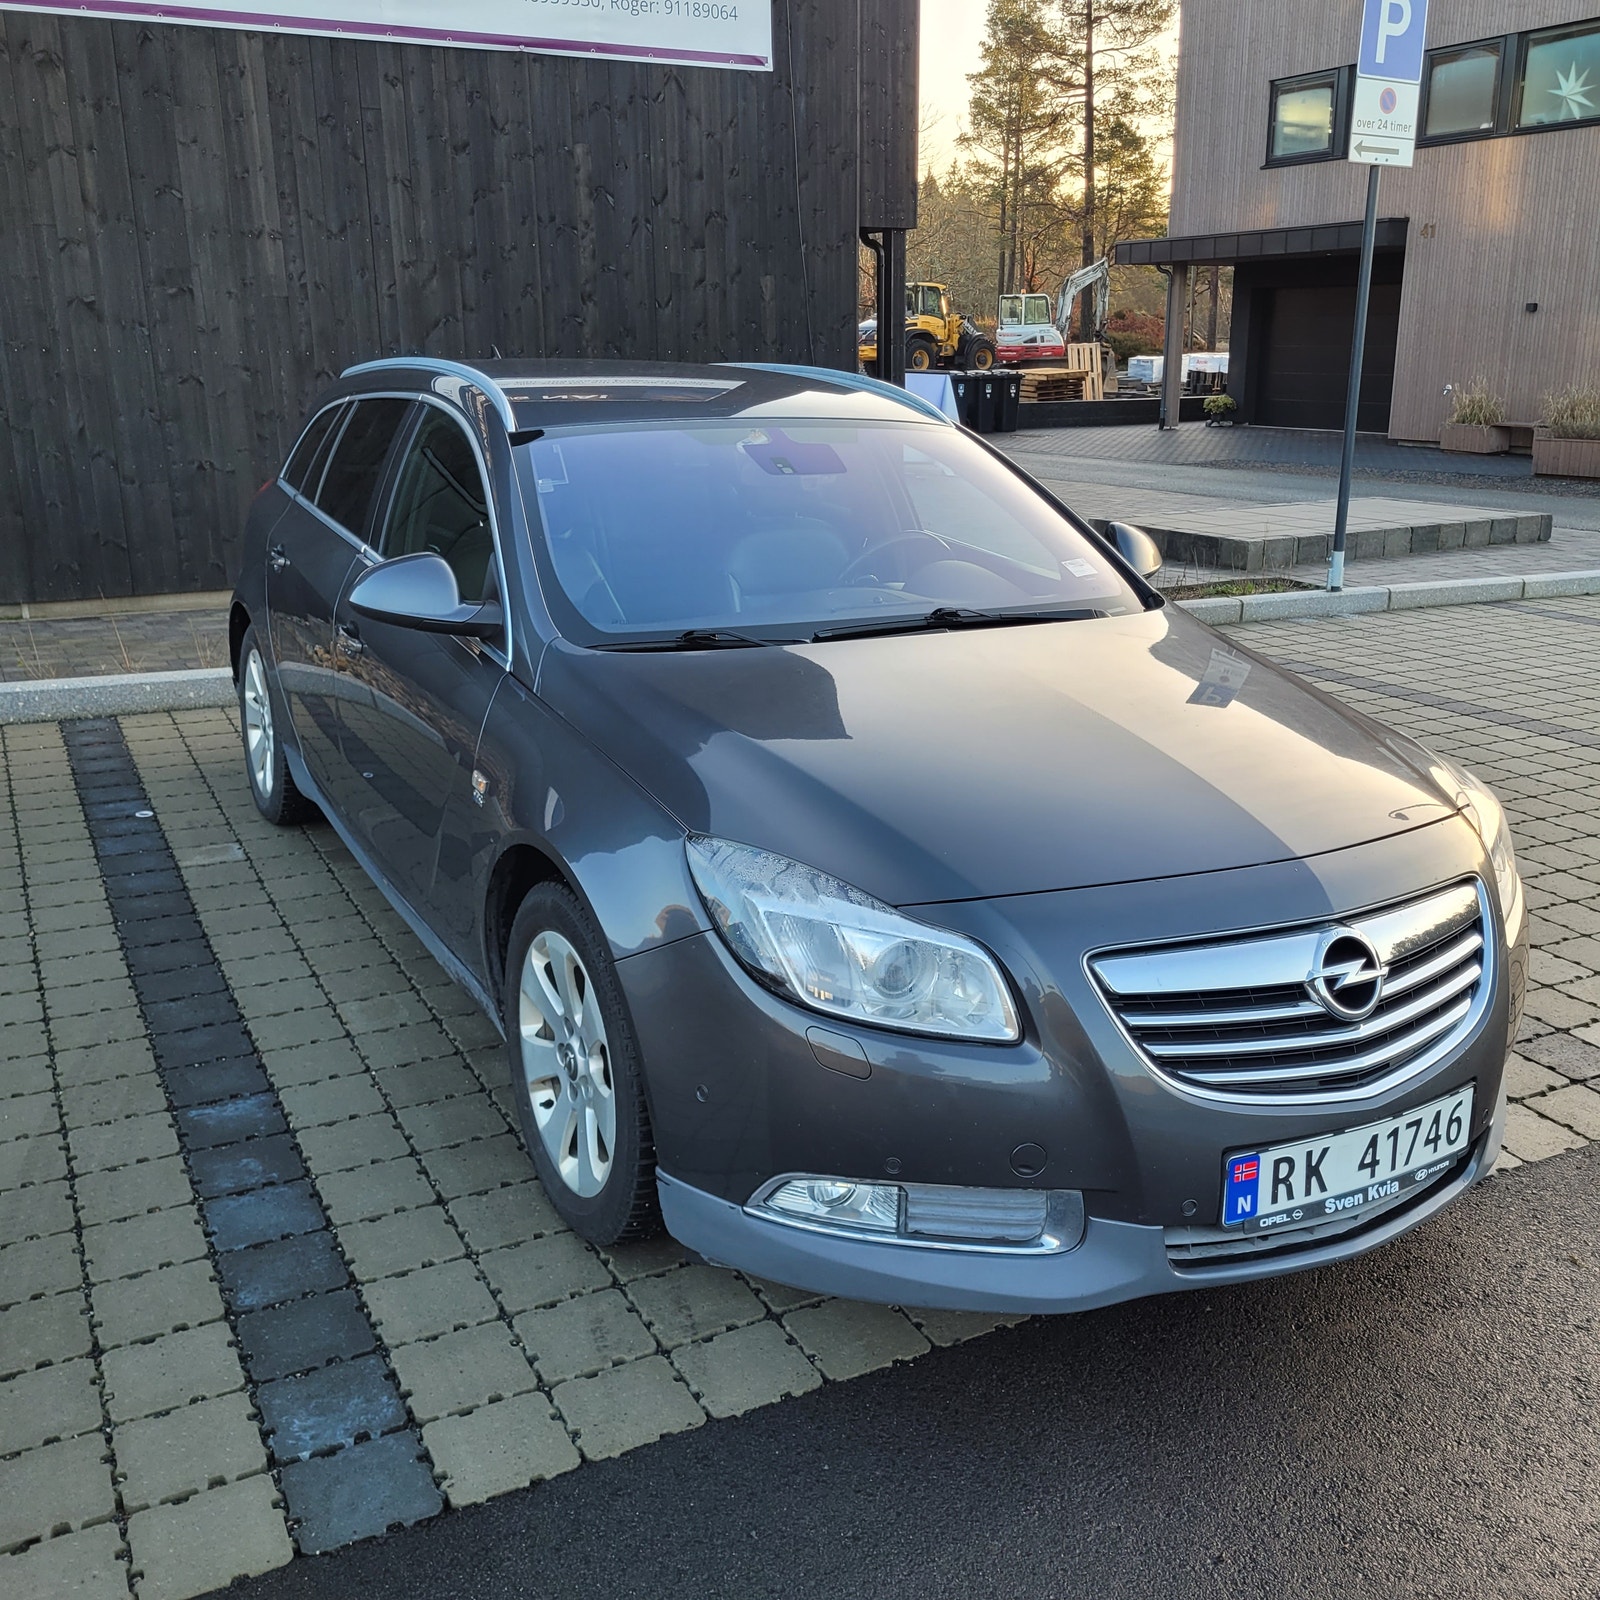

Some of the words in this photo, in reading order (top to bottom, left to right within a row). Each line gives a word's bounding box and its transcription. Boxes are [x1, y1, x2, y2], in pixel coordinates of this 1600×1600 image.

[610, 0, 659, 16] Roger:
[664, 0, 739, 20] 91189064
[1375, 0, 1412, 64] P
[1356, 119, 1375, 129] over
[1377, 118, 1388, 130] 24
[1390, 120, 1412, 133] timer
[1420, 222, 1436, 239] 41
[1271, 1147, 1331, 1206] RK
[1357, 1099, 1464, 1180] 41746
[1237, 1194, 1252, 1215] N
[1324, 1192, 1363, 1214] Sven
[1367, 1179, 1400, 1202] Kvia
[1260, 1214, 1291, 1228] OPEL
